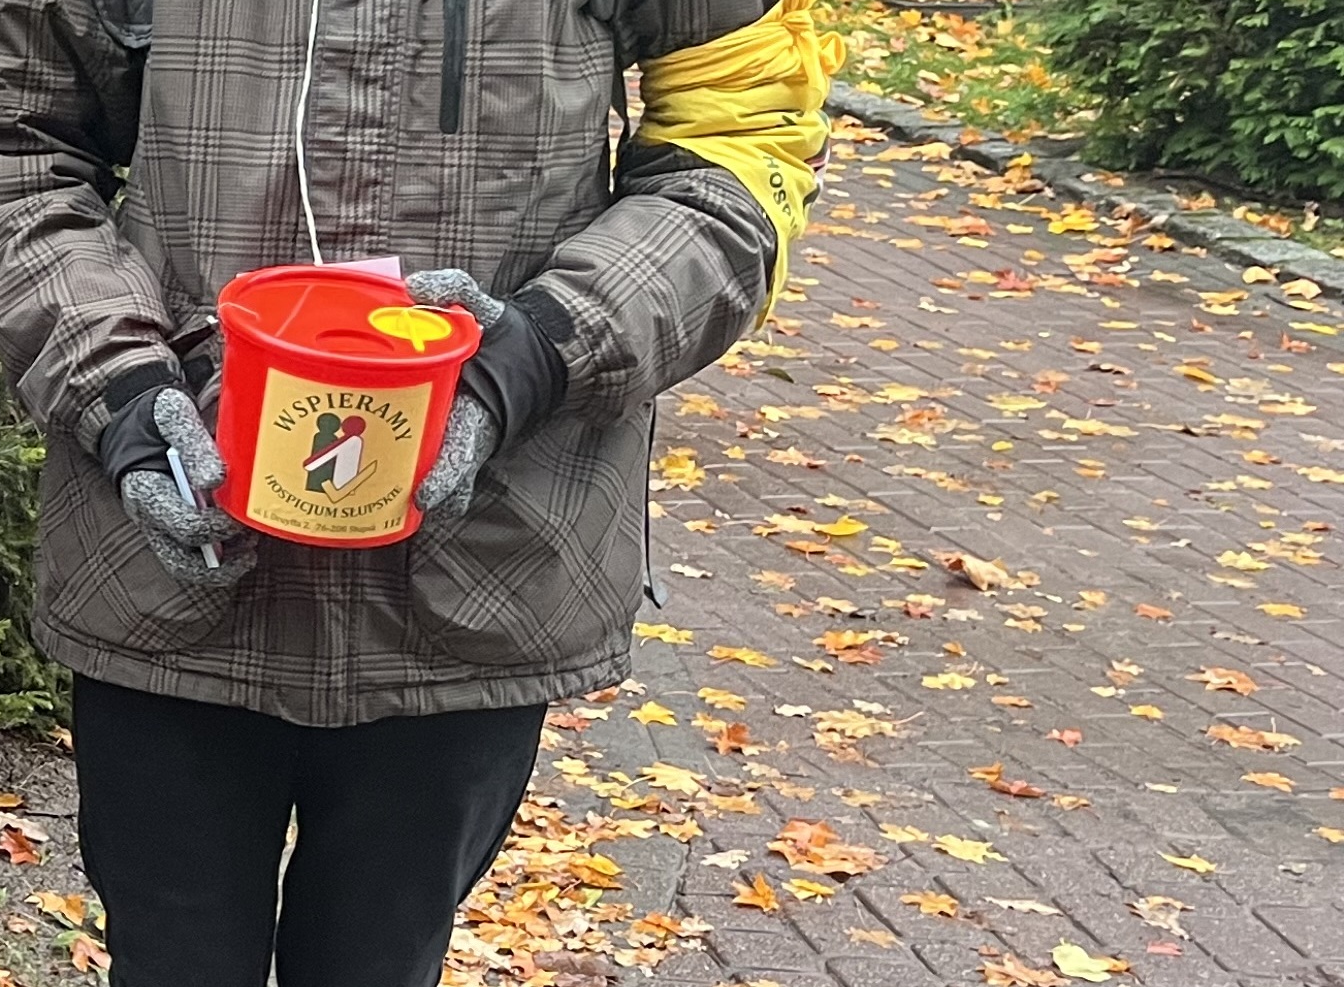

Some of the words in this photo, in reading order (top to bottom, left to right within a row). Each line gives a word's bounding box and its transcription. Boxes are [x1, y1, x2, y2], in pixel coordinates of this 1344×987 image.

[273, 392, 413, 442] WSPIERAMY
[264, 474, 338, 518] HOSPICJUM
[340, 485, 404, 519] SŁUPSKIE
[383, 517, 402, 530] 112
